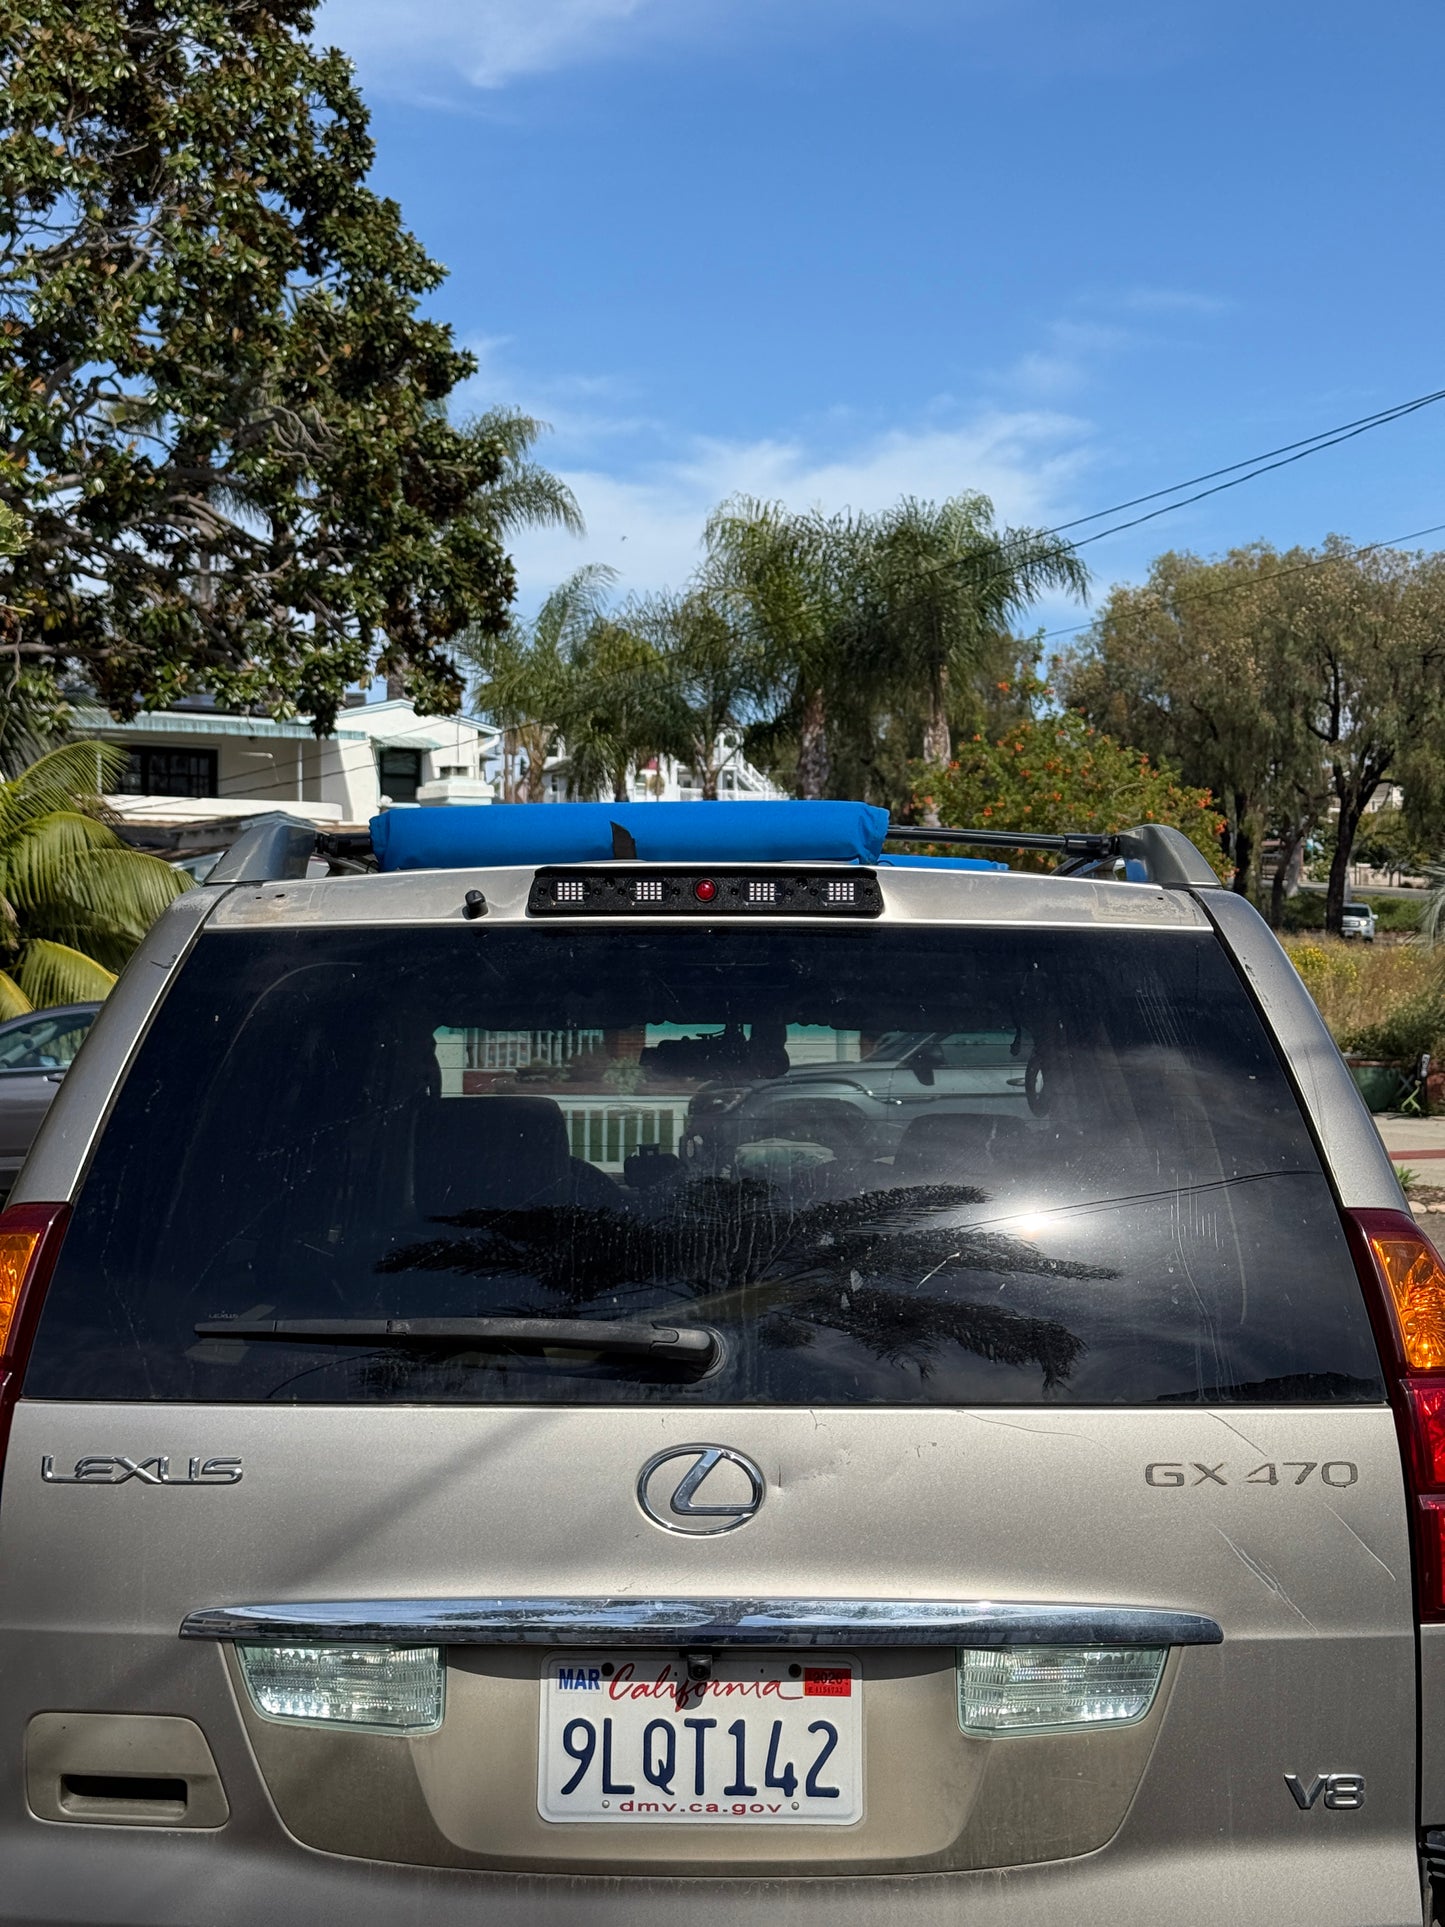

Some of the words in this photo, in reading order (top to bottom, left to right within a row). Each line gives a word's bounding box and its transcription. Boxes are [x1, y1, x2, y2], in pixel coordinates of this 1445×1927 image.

[41, 1455, 243, 1484] LEXUS
[1145, 1462, 1228, 1487] GX
[1246, 1461, 1359, 1488] 470
[558, 1668, 600, 1690] MAR
[608, 1662, 804, 1712] California
[560, 1717, 840, 1798] 9LQT142
[1283, 1773, 1366, 1810] V8
[619, 1800, 782, 1815] dmv.ca.gov
